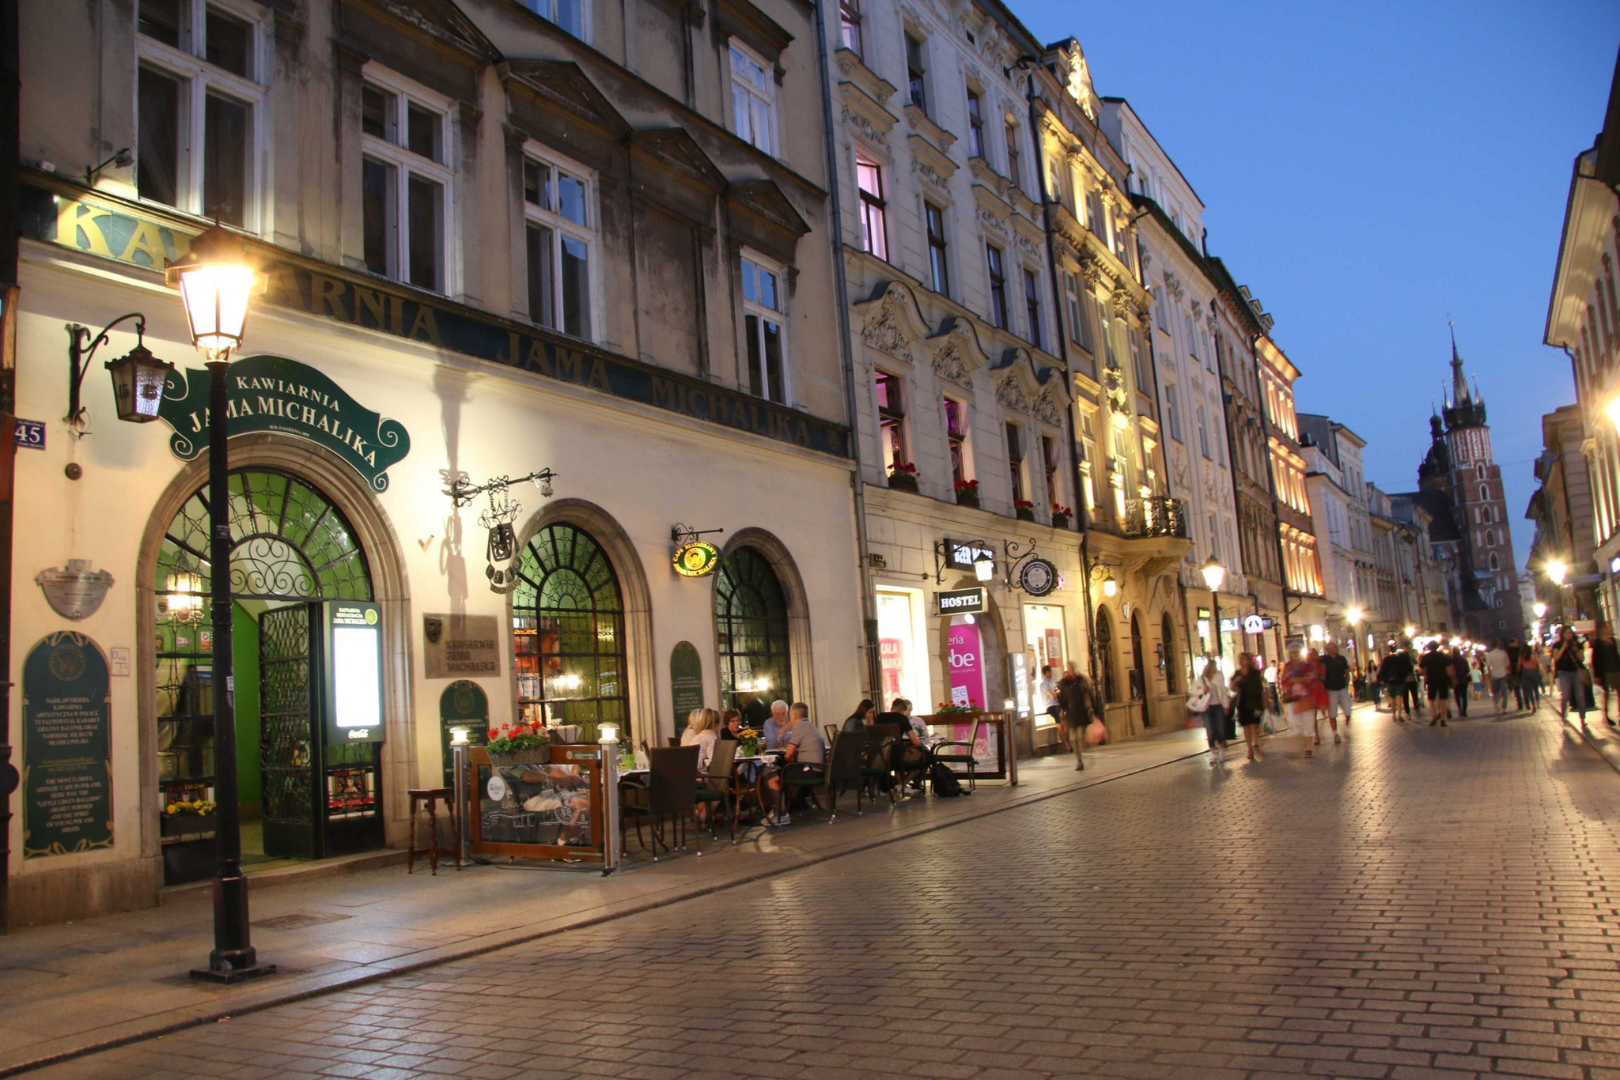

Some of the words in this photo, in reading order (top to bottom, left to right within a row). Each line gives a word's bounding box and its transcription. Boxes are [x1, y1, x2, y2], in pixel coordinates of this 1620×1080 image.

[53, 198, 443, 346] KAARNIA
[496, 331, 611, 393] JAMA
[651, 375, 810, 446] MICHALIKA
[236, 376, 341, 413] KAWIARNIA
[15, 425, 41, 443] 45
[256, 395, 377, 469] MICHALIKA
[953, 544, 972, 565] BEER
[941, 594, 981, 609] HOSTEL
